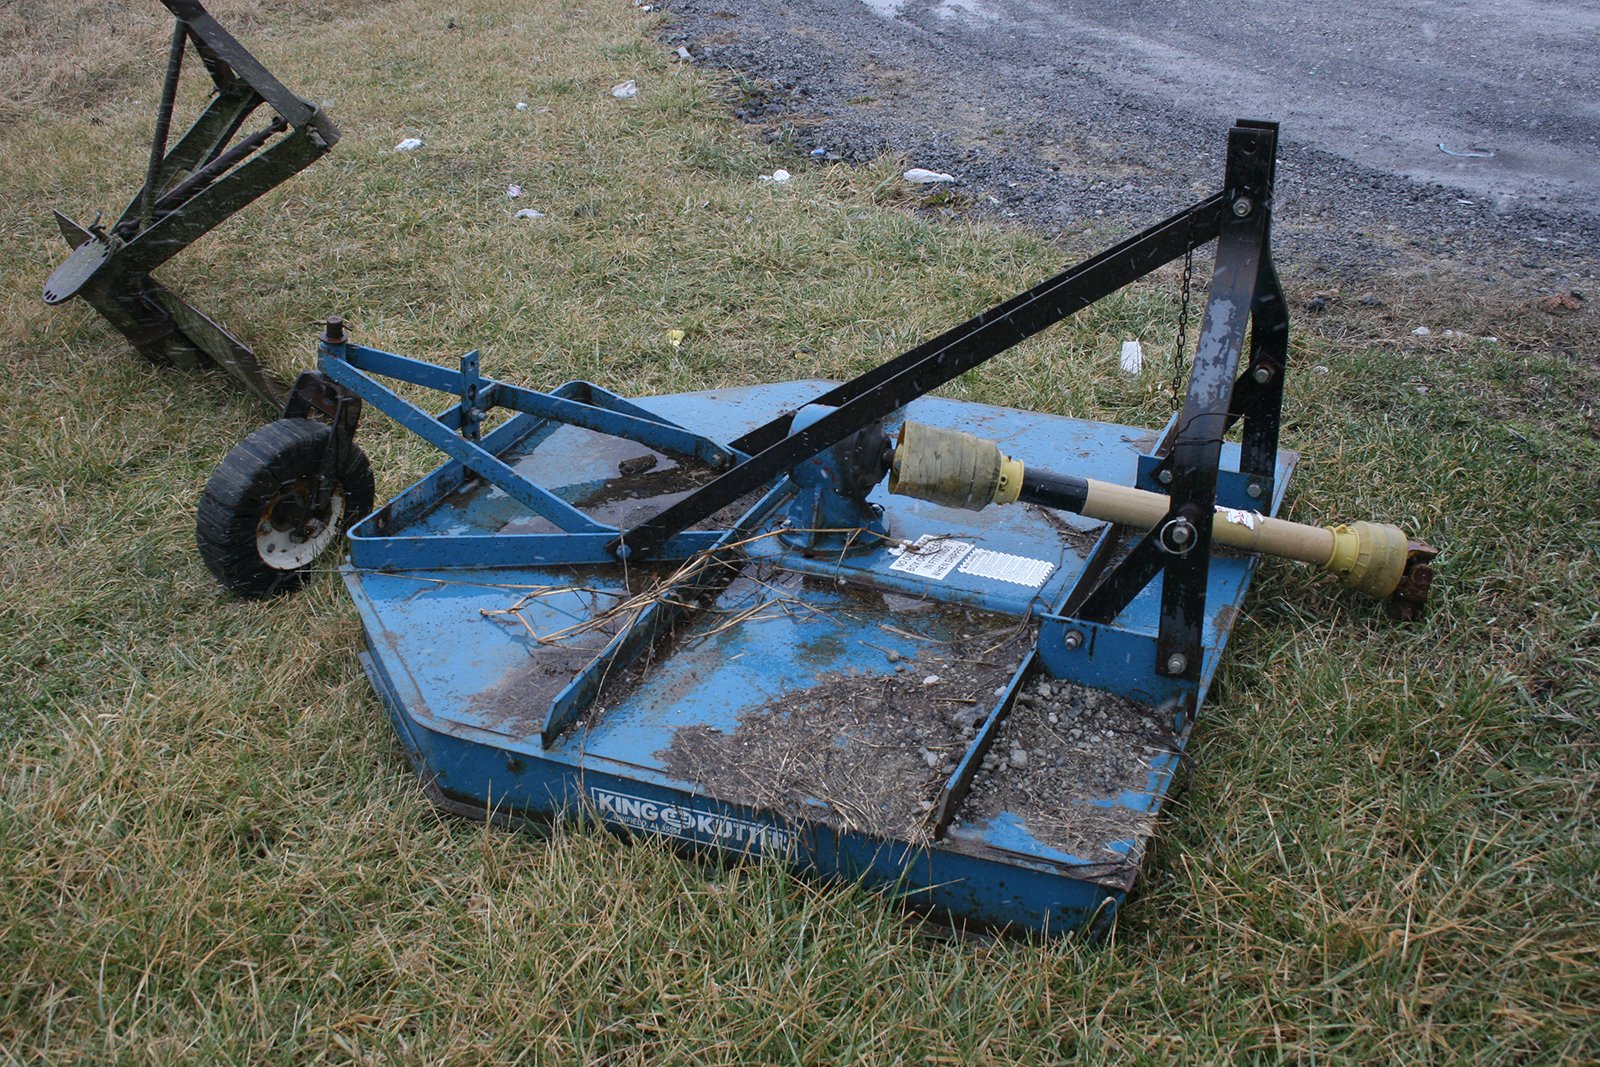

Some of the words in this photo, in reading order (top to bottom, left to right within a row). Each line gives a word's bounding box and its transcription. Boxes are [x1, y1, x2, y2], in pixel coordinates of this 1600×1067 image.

[931, 562, 949, 576] WHEN
[944, 545, 967, 563] SHIPPED
[598, 793, 658, 821] KING
